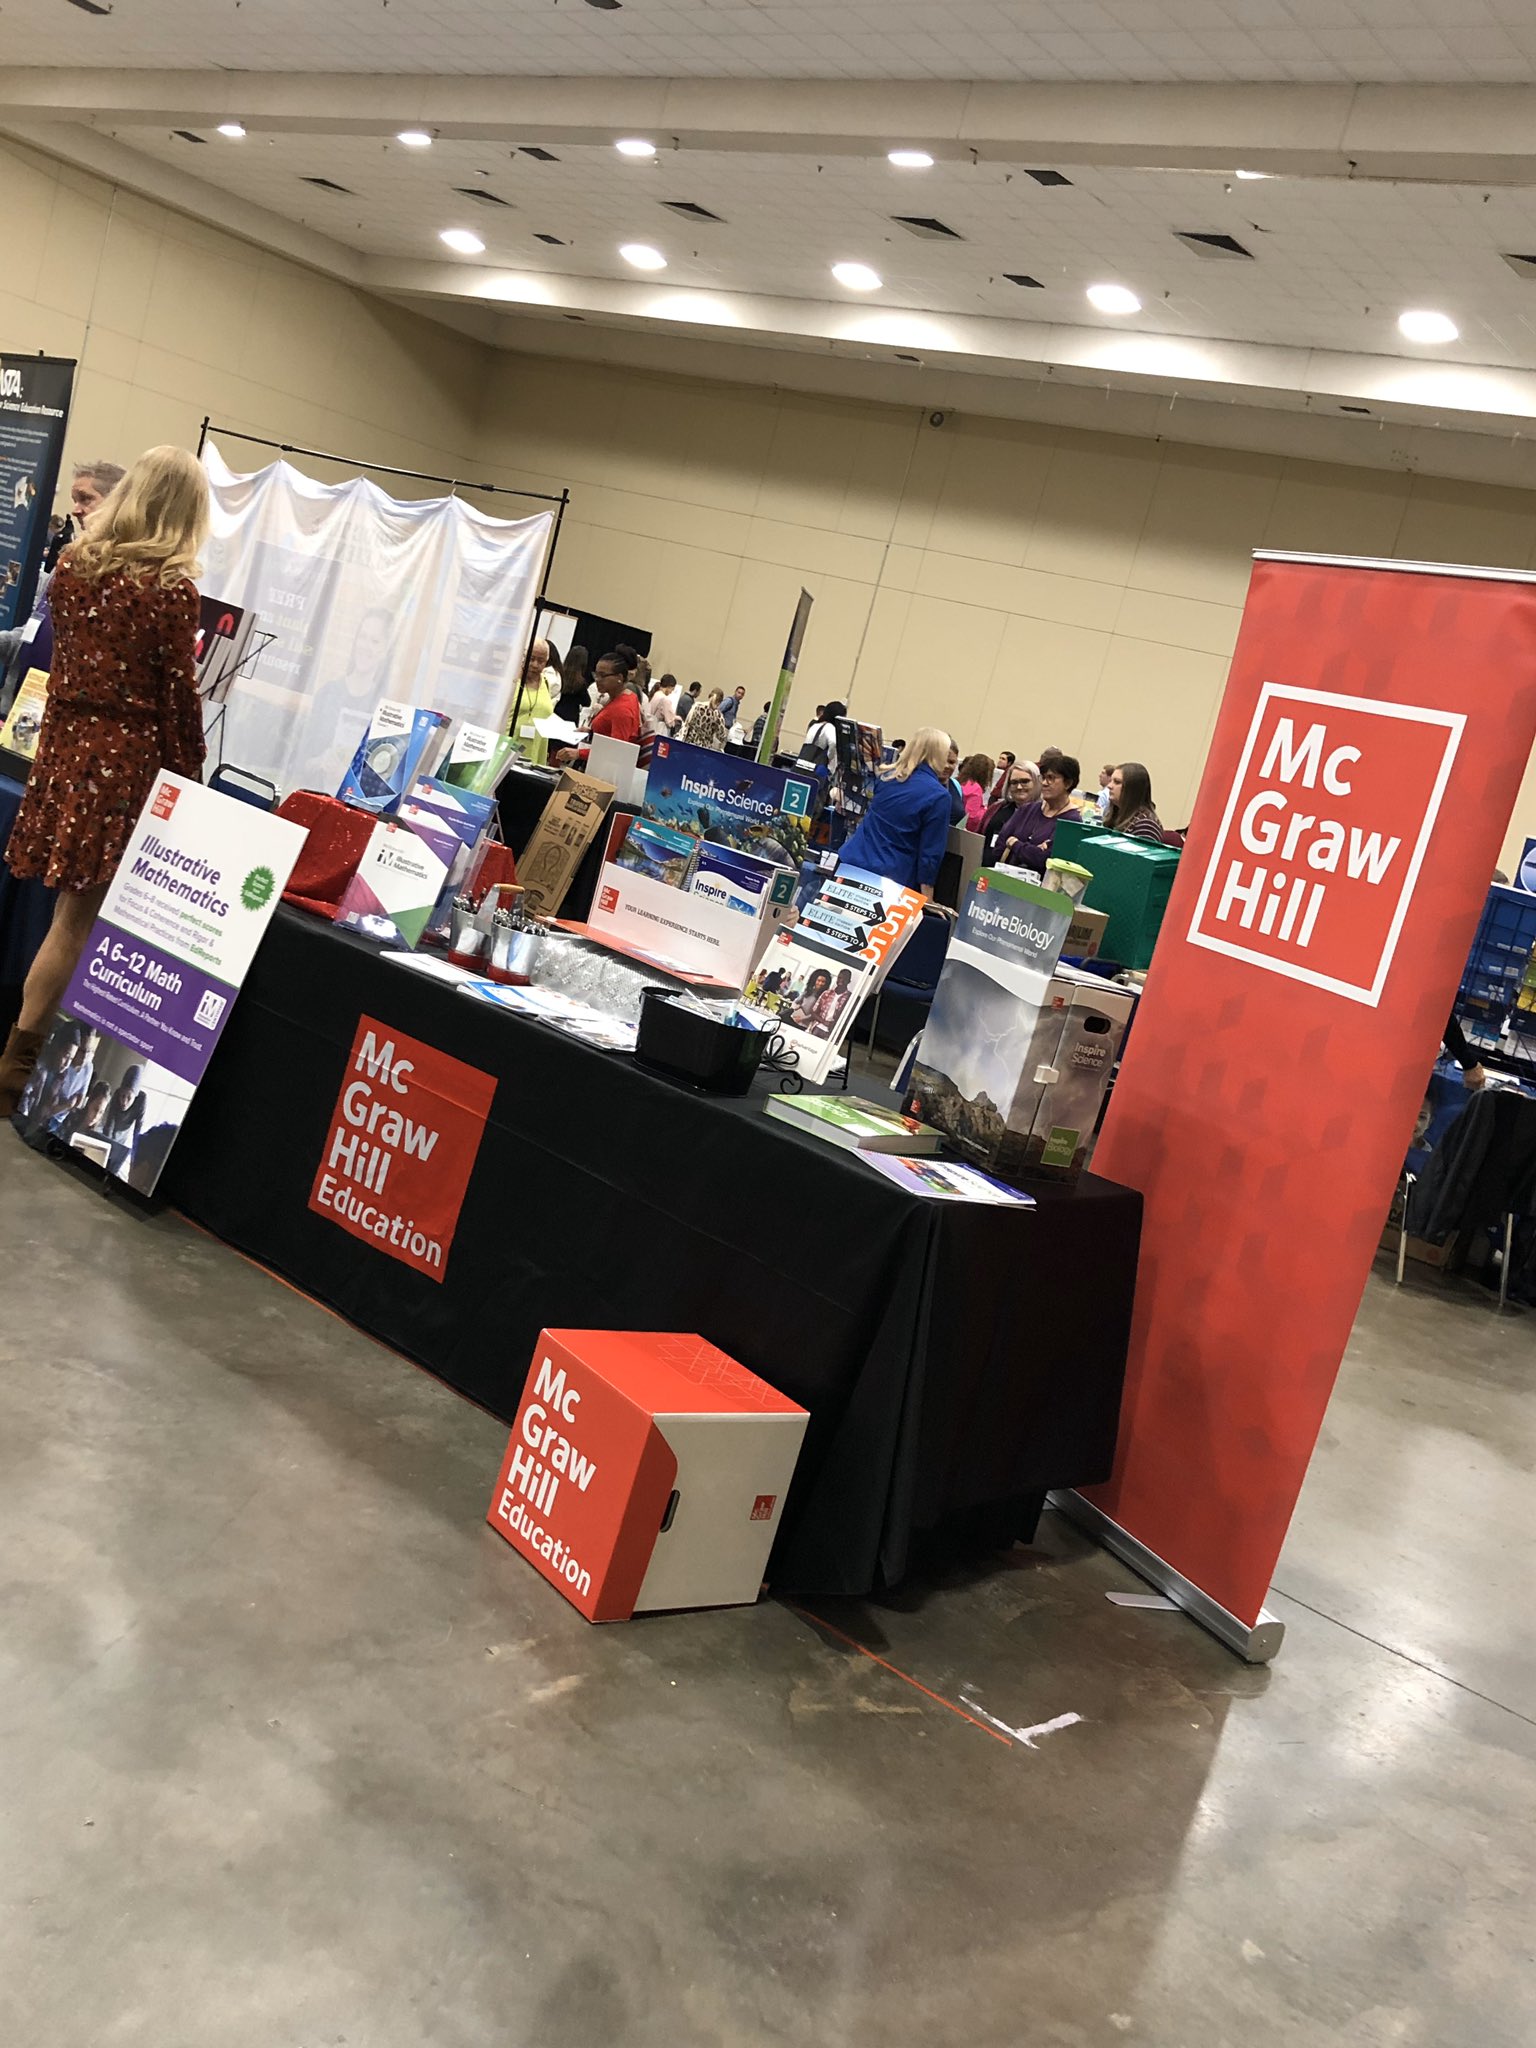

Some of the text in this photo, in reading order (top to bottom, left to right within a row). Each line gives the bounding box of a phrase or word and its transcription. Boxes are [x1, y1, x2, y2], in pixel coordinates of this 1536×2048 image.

[1258, 717, 1362, 796] Mc
[681, 774, 774, 816] Inspire Science
[790, 793, 799, 808] 2
[140, 835, 221, 885] Illustrative
[1240, 790, 1401, 886] Graw
[131, 858, 229, 917] Mathematics
[695, 879, 727, 900] Inspire
[777, 884, 787, 899] 2
[826, 884, 854, 900] ELITE
[863, 885, 882, 897] STEPS
[1216, 859, 1326, 948] Hill
[179, 912, 202, 926] perfect
[201, 922, 223, 937] scores
[637, 909, 660, 924] LEARNING
[660, 918, 688, 934] EXPERIENCE
[688, 928, 706, 942] STARTS
[807, 906, 834, 922] ELITE
[849, 904, 868, 916] STEPS
[868, 911, 877, 920] TO
[879, 911, 905, 936] 5
[968, 900, 1009, 930] Inspire
[1008, 915, 1054, 951] Biology
[96, 936, 111, 957] A
[145, 960, 183, 995] Math
[829, 929, 850, 942] STEPS
[849, 936, 859, 945] TO
[859, 936, 887, 962] 5
[89, 957, 163, 1011] Curriculum
[355, 1030, 415, 1094] Mc
[1071, 1053, 1104, 1068] Science
[1075, 1042, 1106, 1058] Inspire
[342, 1081, 439, 1162] Graw
[328, 1126, 392, 1195] Hill
[316, 1173, 443, 1268] Education
[533, 1357, 581, 1423] Mc
[522, 1403, 597, 1492] Graw
[507, 1444, 560, 1517] Hill
[497, 1487, 592, 1597] Education
